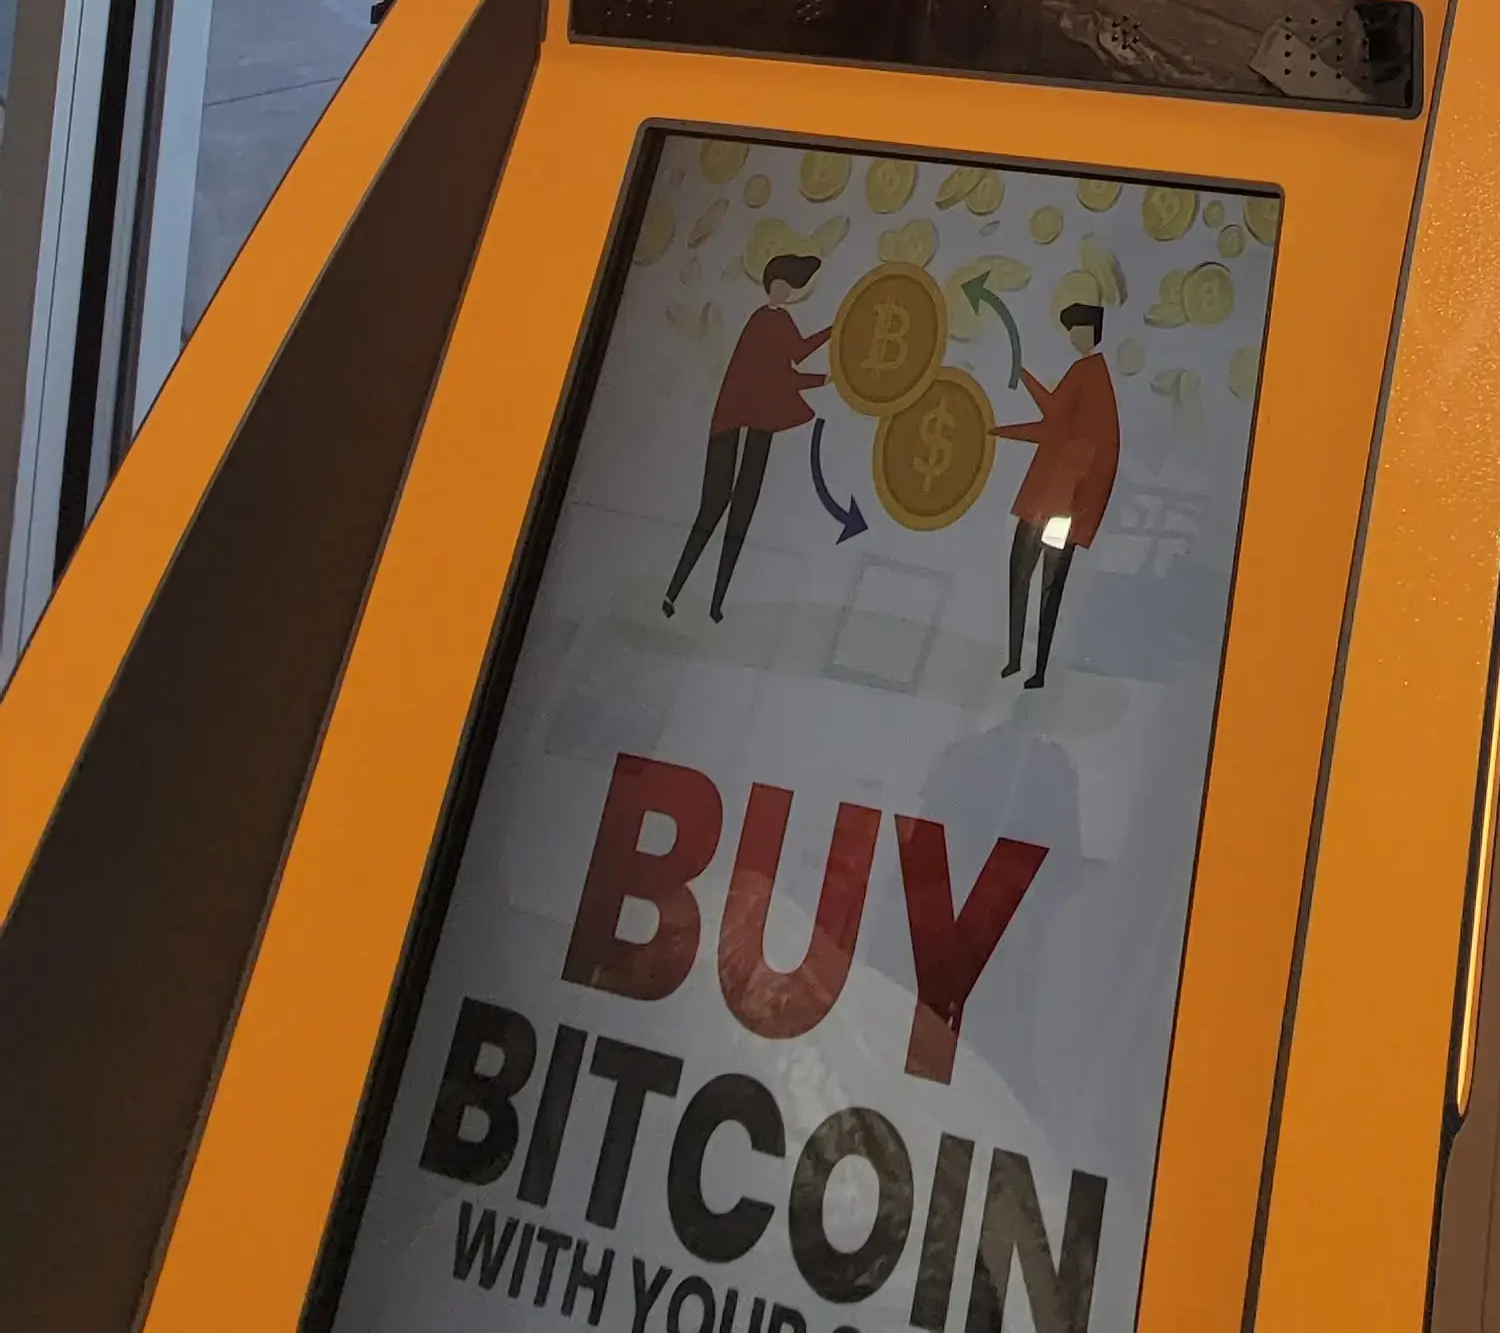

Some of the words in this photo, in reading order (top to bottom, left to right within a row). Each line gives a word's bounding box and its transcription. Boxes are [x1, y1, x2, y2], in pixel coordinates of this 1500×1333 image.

[561, 752, 1050, 1086] BUY
[420, 997, 1108, 1333] BITCOIN
[452, 1200, 614, 1325] WITH
[632, 1255, 808, 1333] YOU
